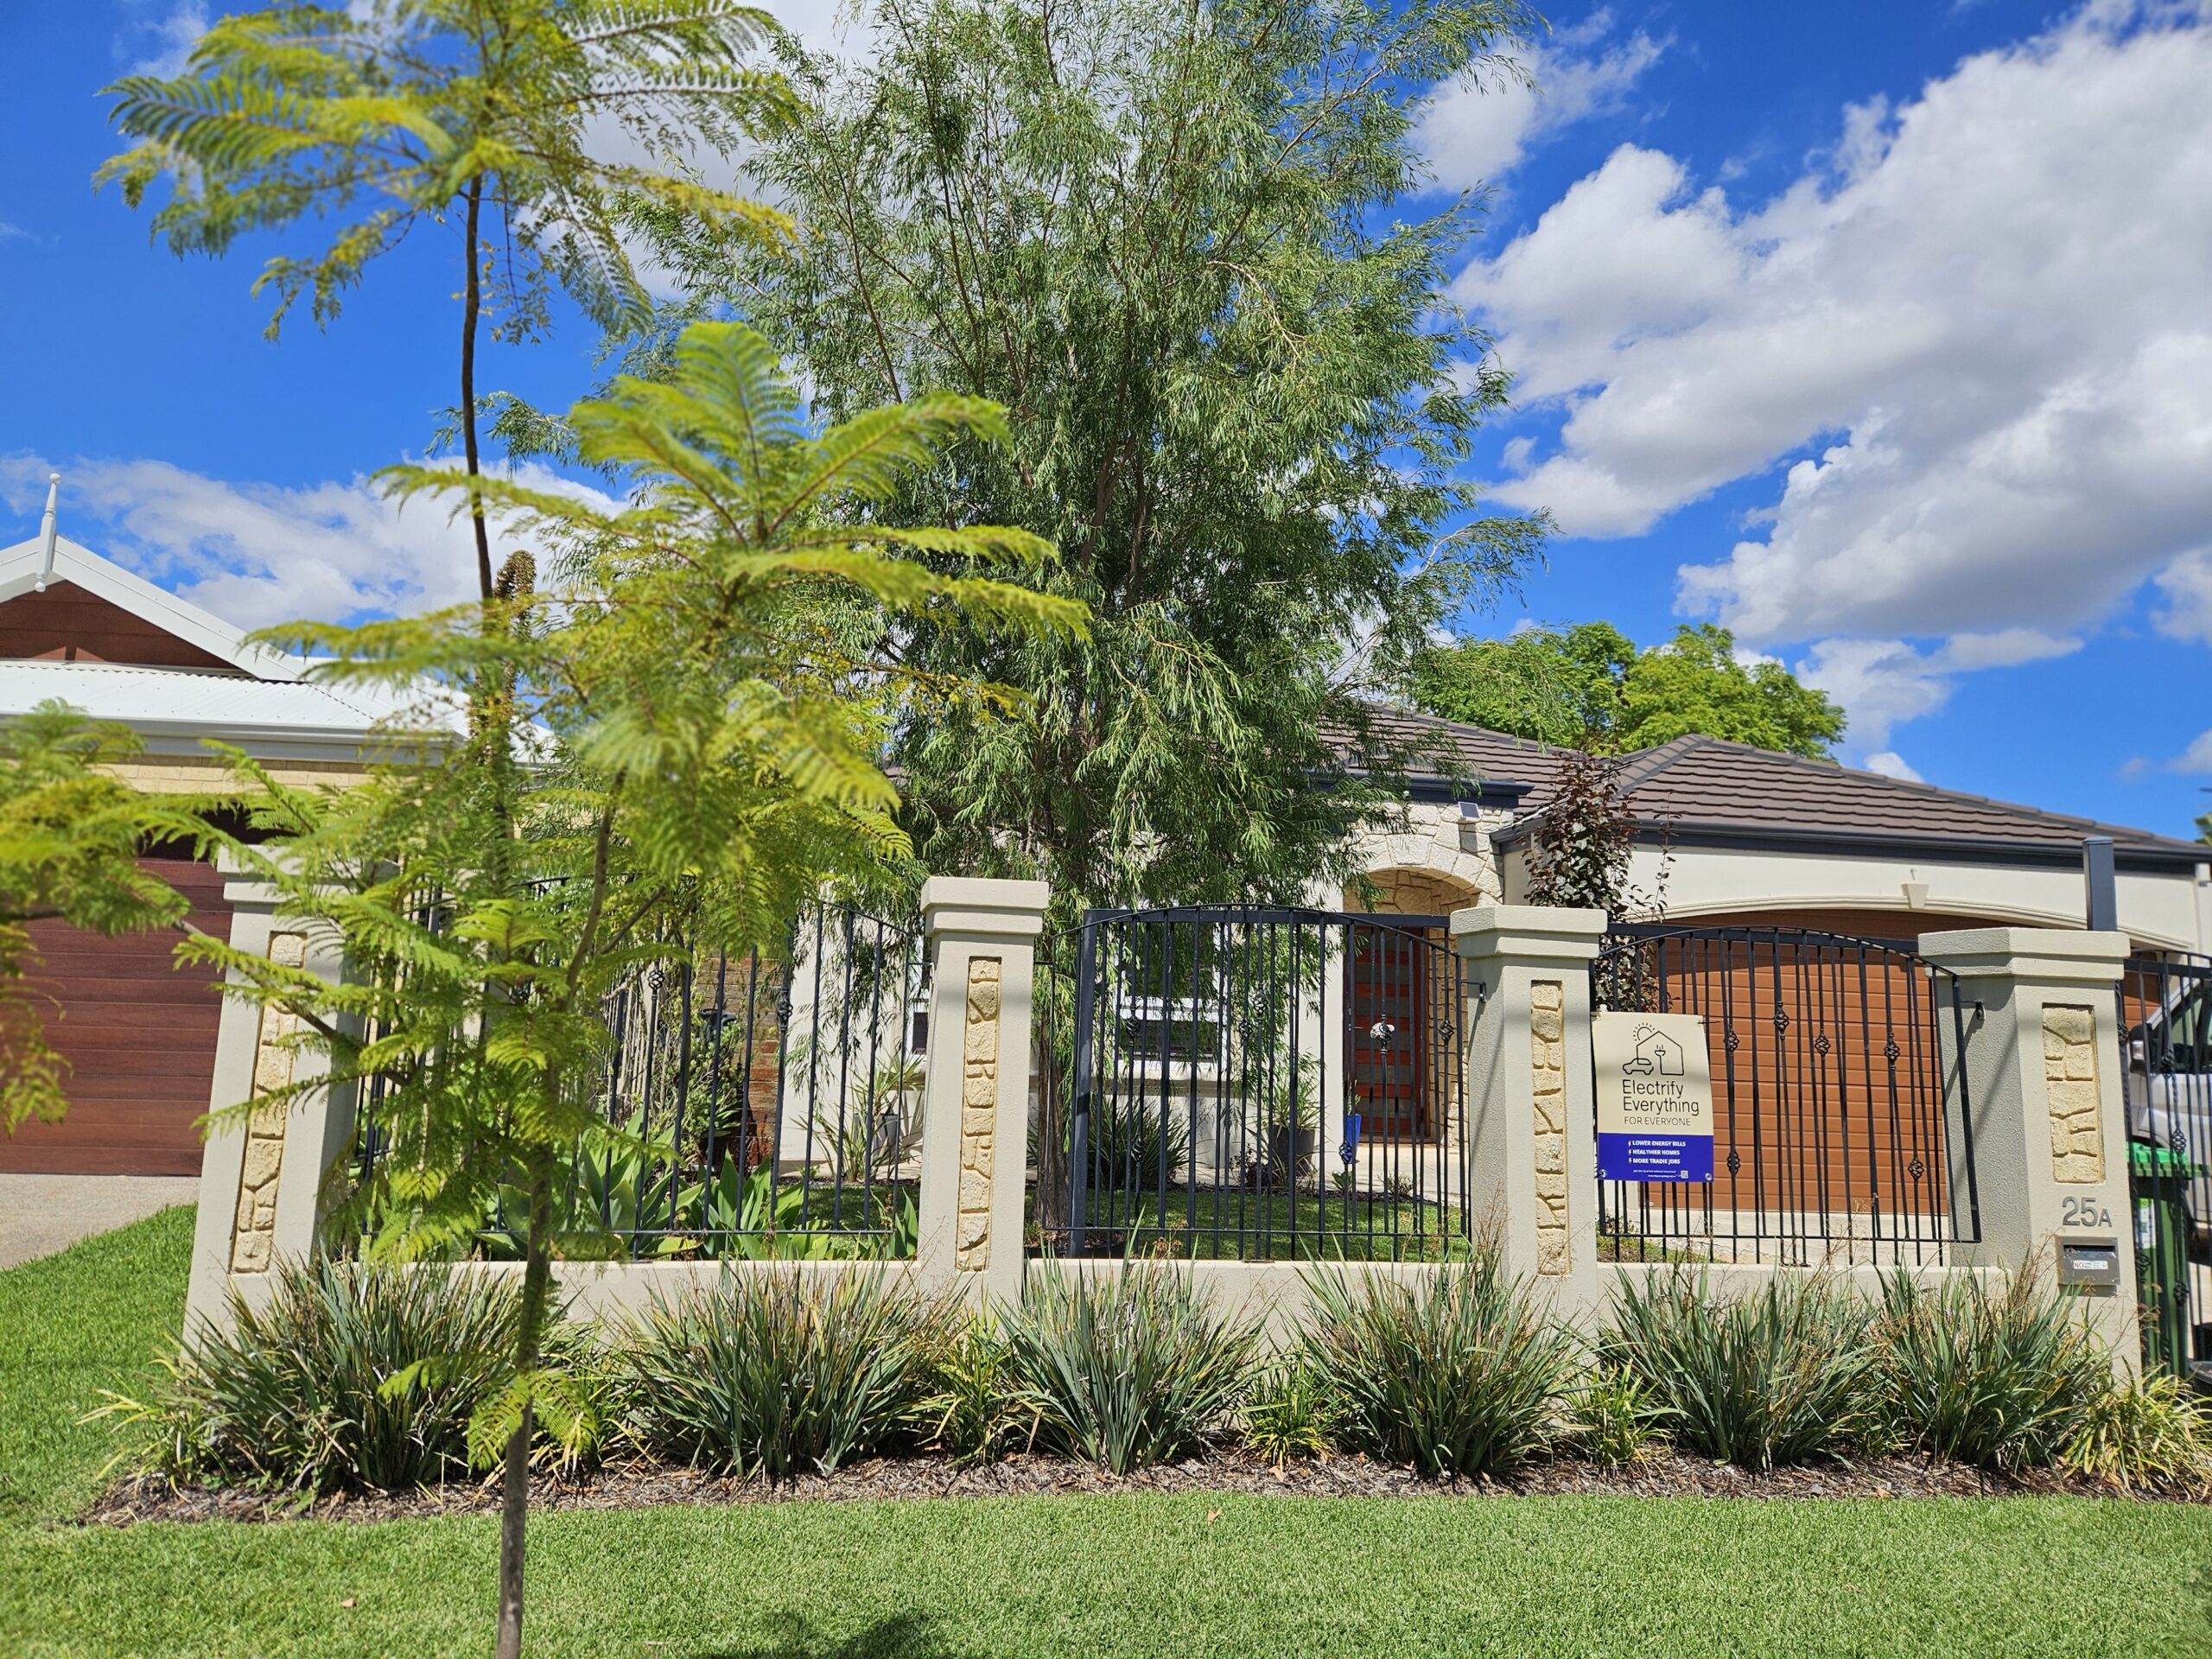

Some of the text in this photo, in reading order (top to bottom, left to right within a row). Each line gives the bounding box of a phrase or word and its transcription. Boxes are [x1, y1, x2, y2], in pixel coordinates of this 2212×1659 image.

[1623, 1079, 1683, 1098] Electrify
[1624, 1096, 1699, 1116] Everything
[1644, 1117, 1690, 1126] EVERYONE
